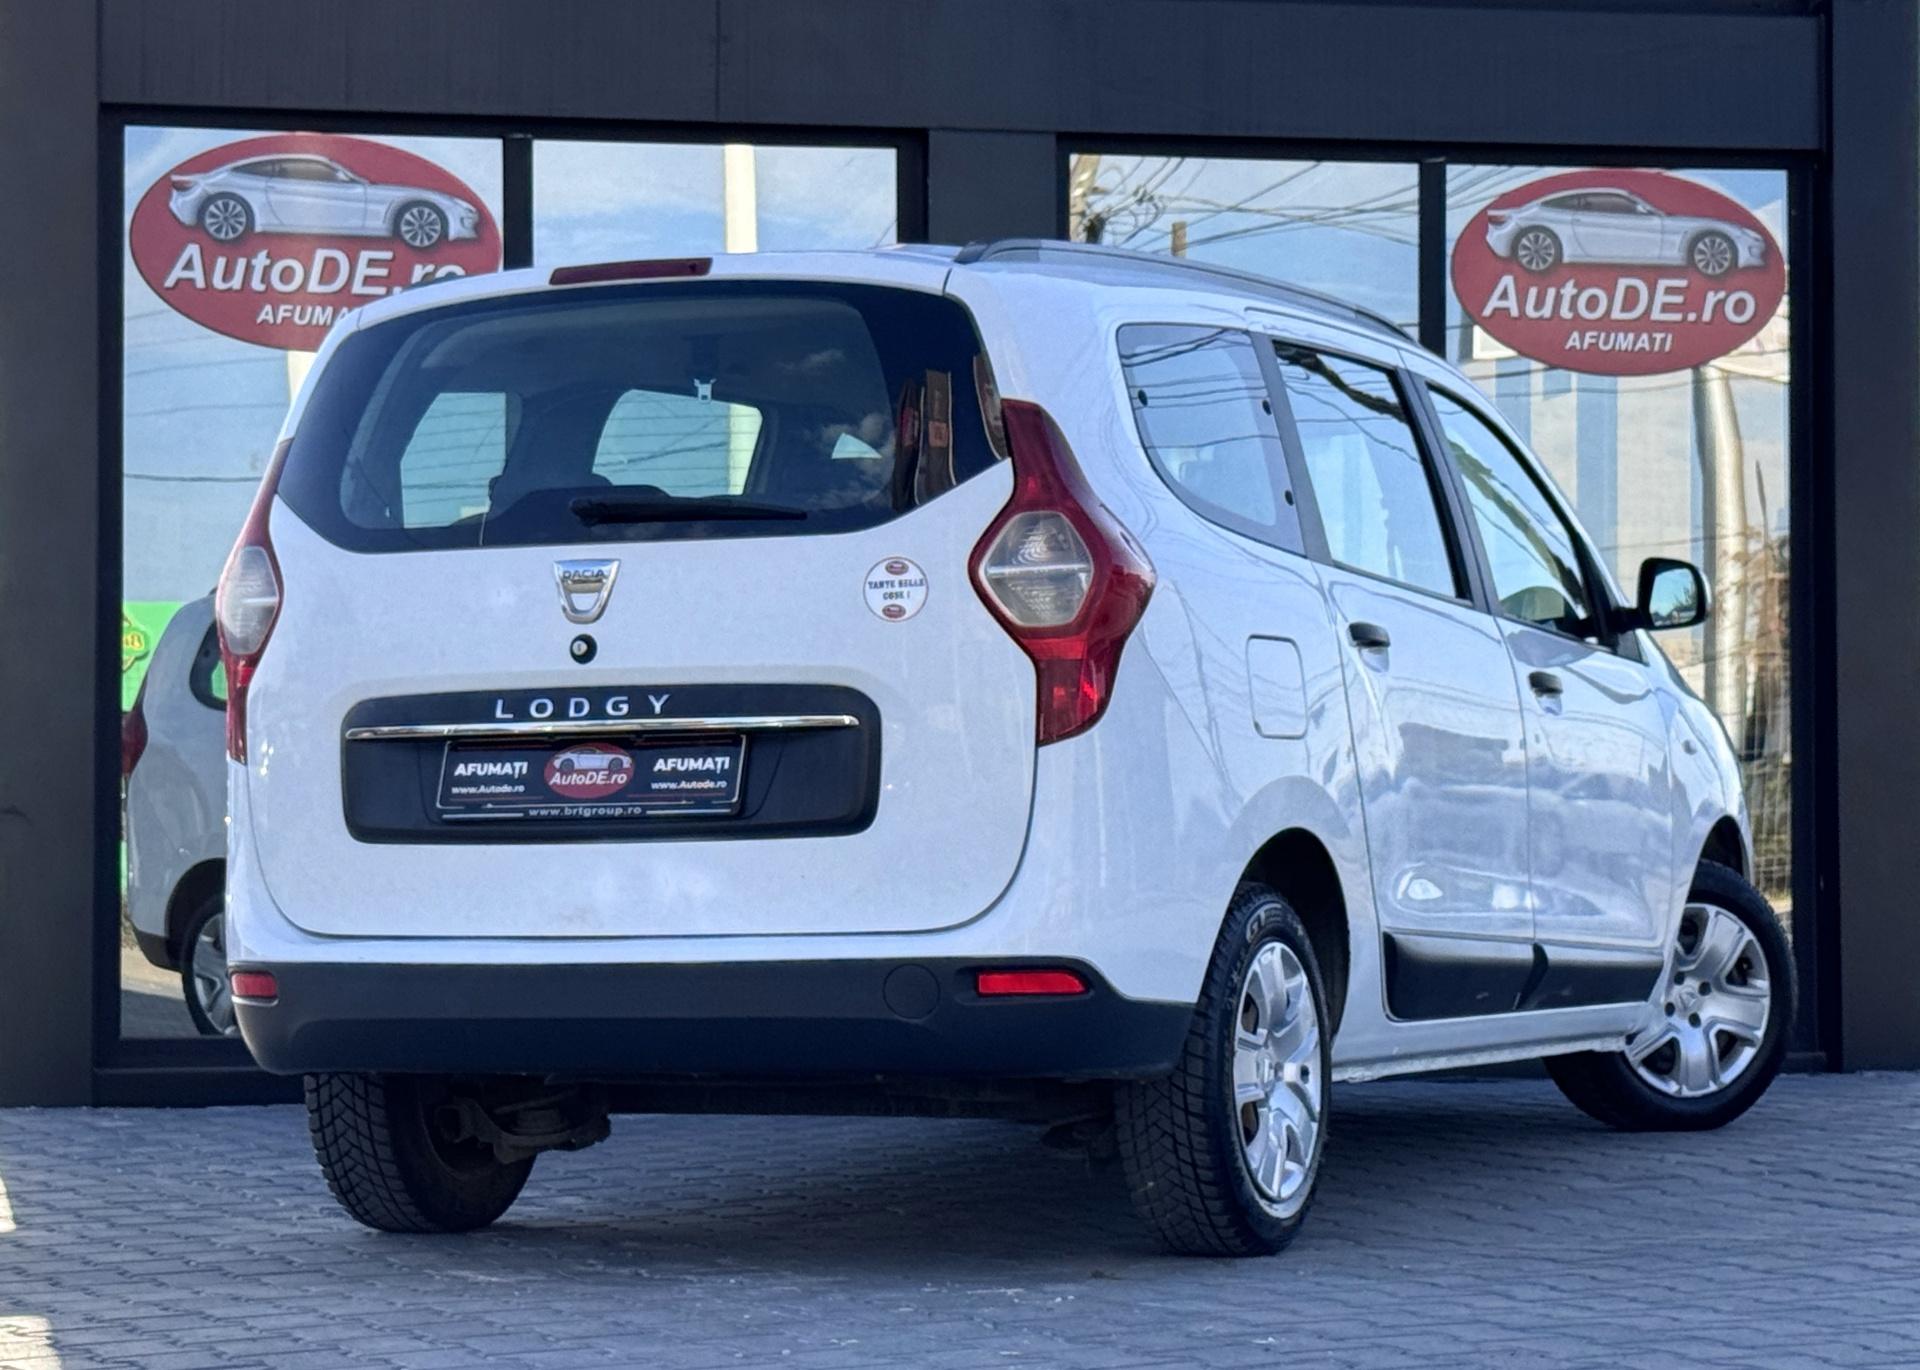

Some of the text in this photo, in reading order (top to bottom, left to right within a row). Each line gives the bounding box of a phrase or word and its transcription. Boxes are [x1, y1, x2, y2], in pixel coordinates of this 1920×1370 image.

[1481, 275, 1756, 324] AutoDE.ro
[1565, 331, 1673, 352] AFUMATI
[562, 569, 606, 580] DACIA
[495, 694, 671, 719] LODGY
[548, 769, 628, 786] AutoDE.ro
